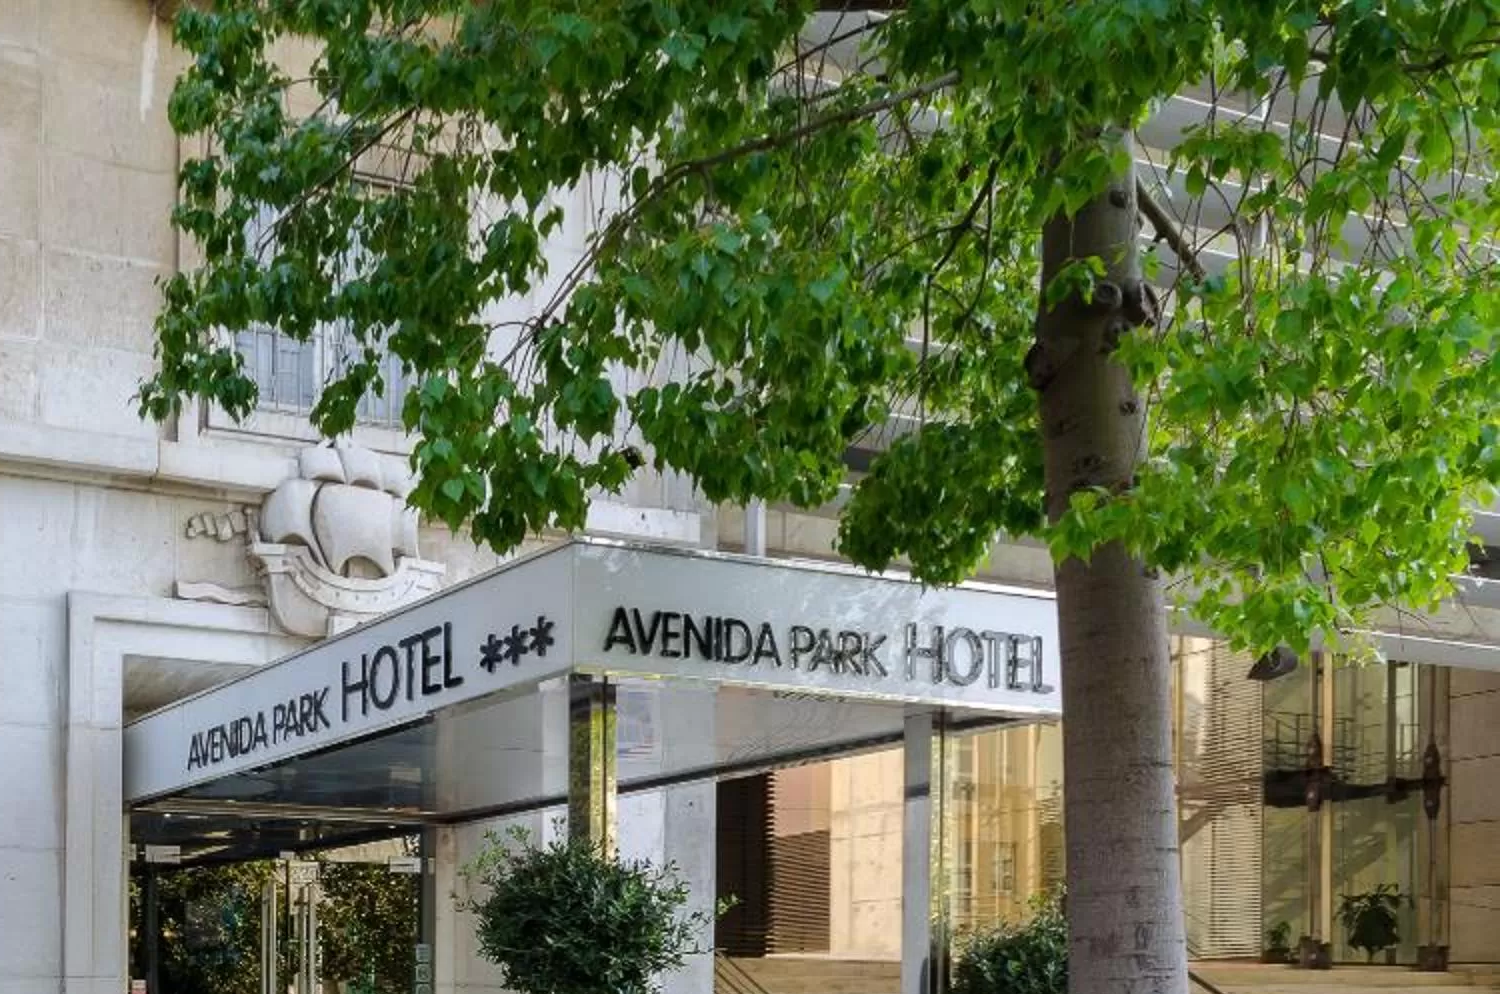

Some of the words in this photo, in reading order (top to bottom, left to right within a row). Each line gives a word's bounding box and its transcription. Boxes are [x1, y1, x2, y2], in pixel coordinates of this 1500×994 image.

[187, 712, 269, 772] AVENIDA
[272, 686, 331, 744] PARK
[341, 622, 464, 721] HOTEL
[603, 606, 781, 667] AVENIDA
[791, 625, 888, 678] PARK
[903, 622, 1052, 694] HOTEL
